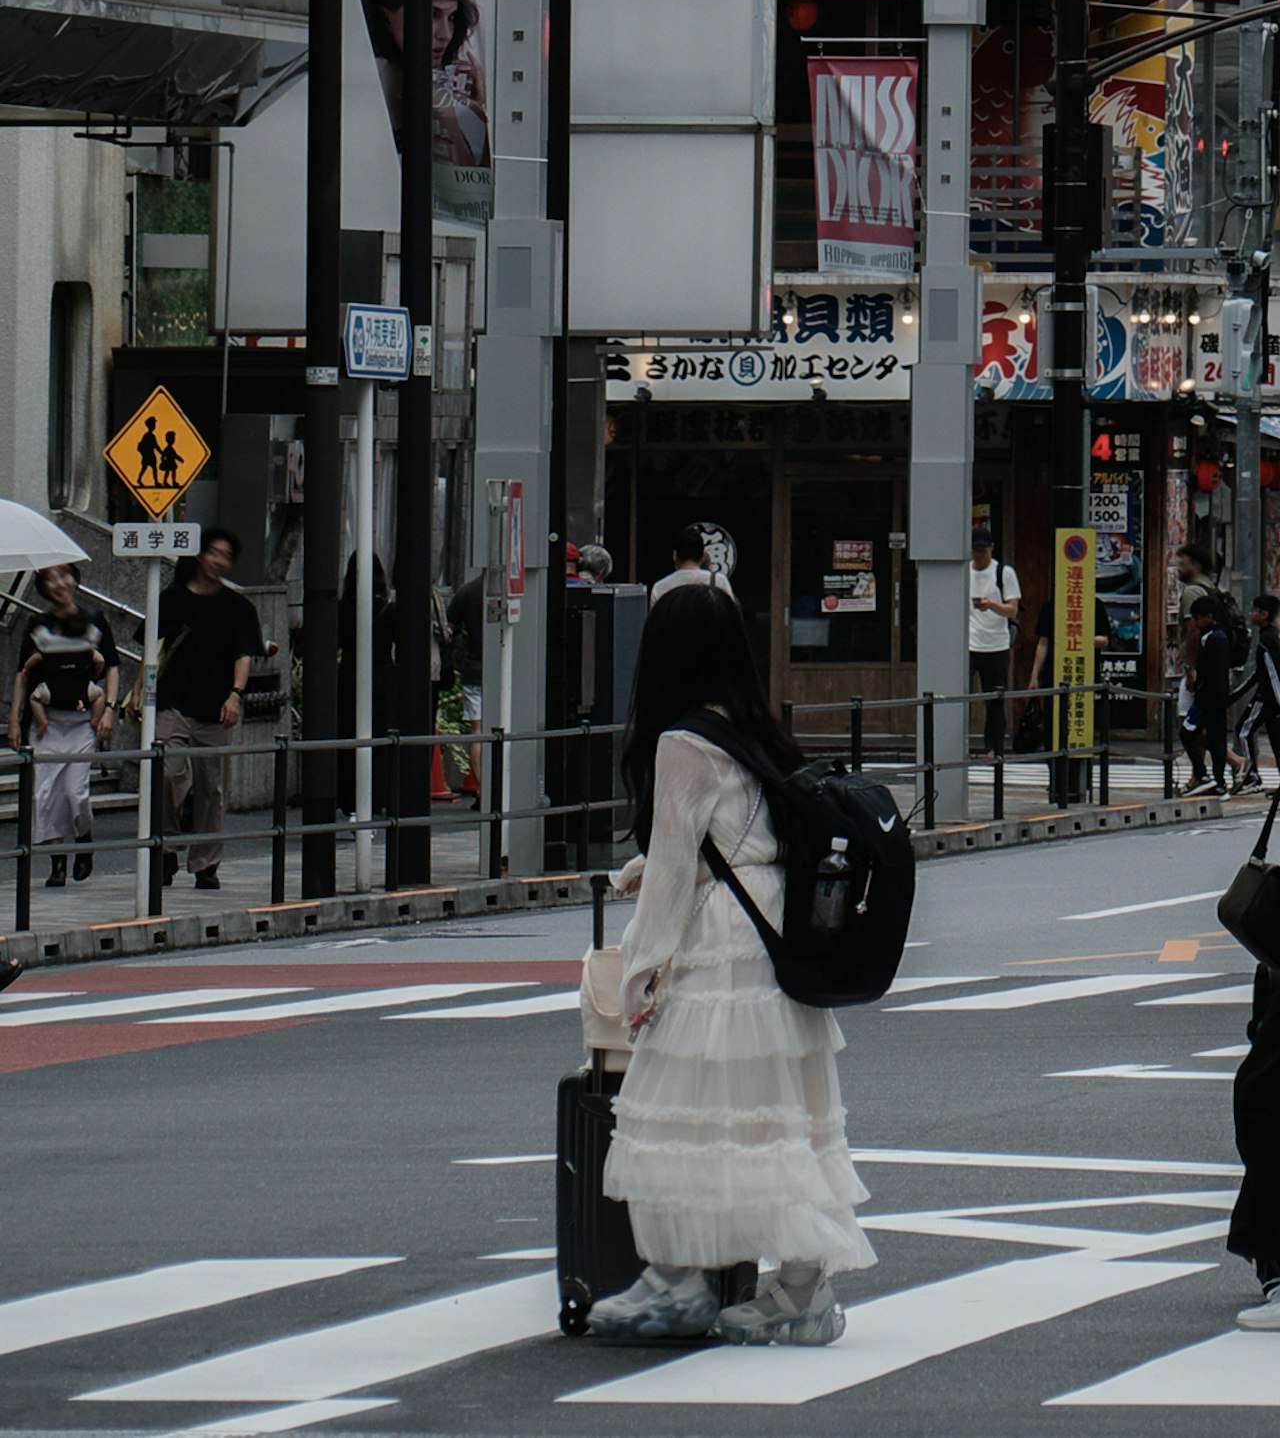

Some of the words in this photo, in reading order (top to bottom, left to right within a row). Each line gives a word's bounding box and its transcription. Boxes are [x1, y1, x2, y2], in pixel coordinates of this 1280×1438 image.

[816, 74, 916, 153] MISS
[816, 148, 916, 229] DIOR
[646, 355, 724, 381] さかな
[122, 530, 191, 550] 通学路
[1066, 566, 1083, 653] 違法駐車禁止
